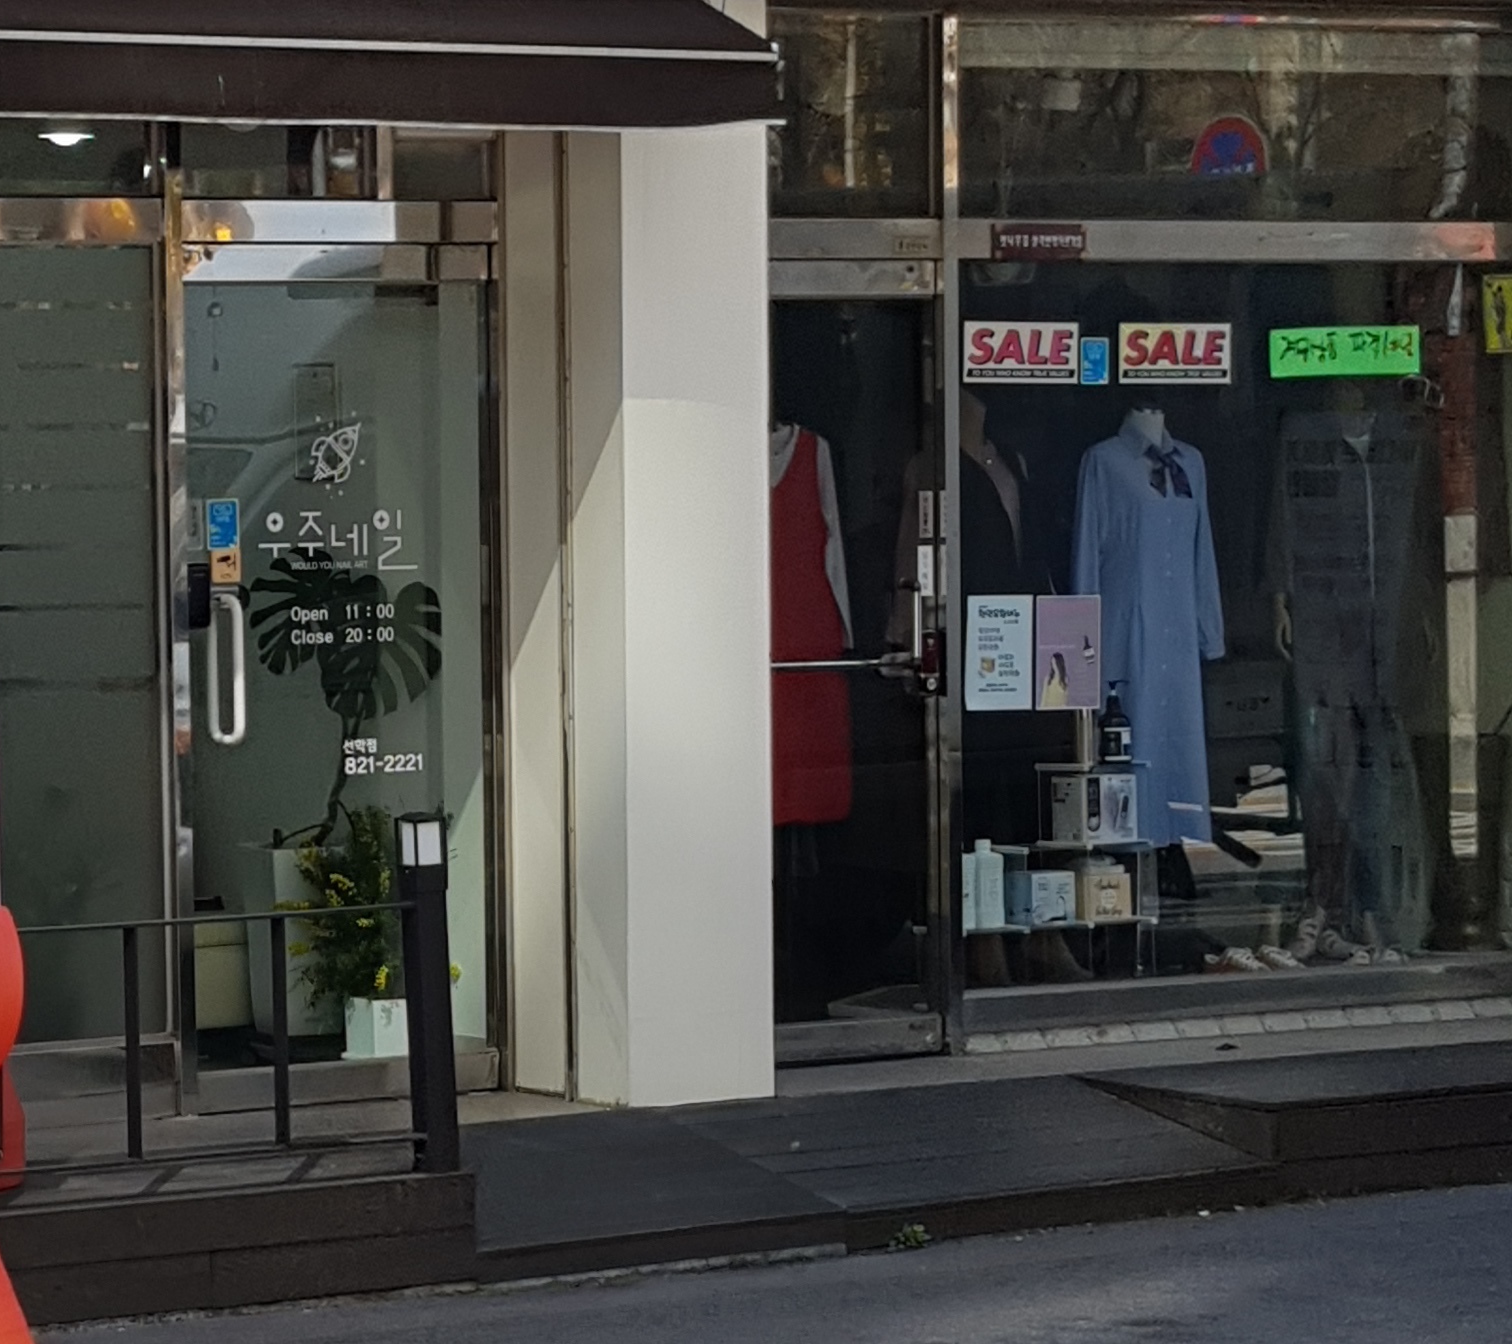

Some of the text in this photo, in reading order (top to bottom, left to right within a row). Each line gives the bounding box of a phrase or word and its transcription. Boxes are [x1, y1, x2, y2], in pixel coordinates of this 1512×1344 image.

[968, 327, 1074, 365] SALE
[1123, 329, 1226, 366] SALE
[258, 509, 418, 571] 우주네일
[291, 561, 318, 570] WOULD
[319, 561, 335, 570] YOU
[290, 606, 329, 624] Open
[290, 629, 334, 645] Close
[343, 738, 377, 754] 선학점
[344, 753, 423, 775] 821-2221
